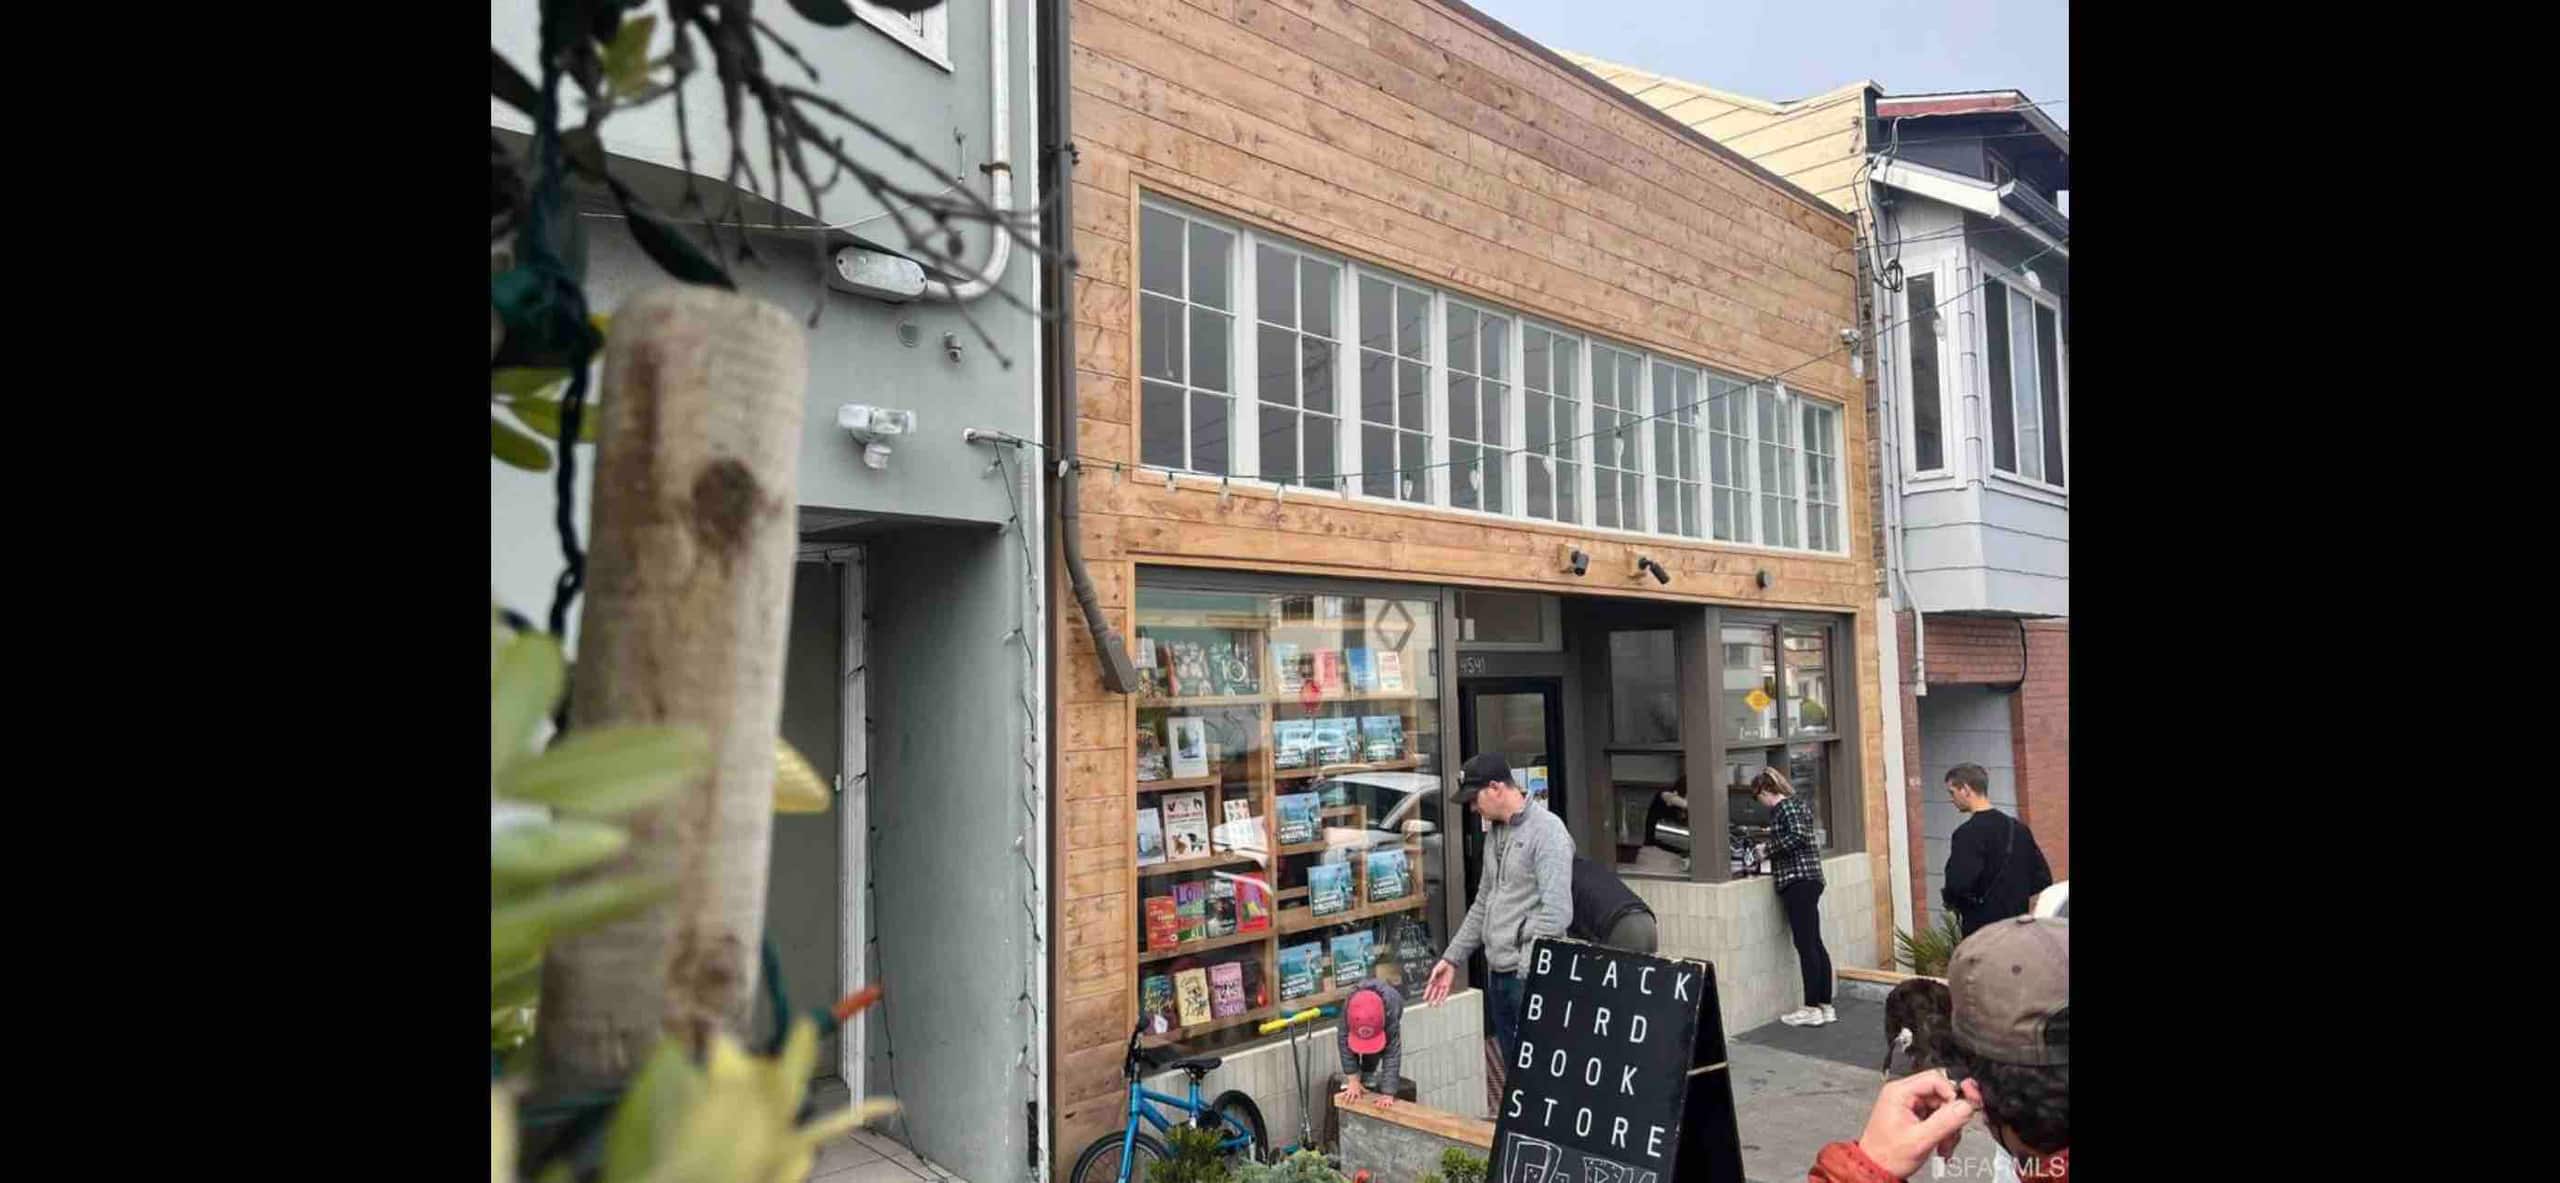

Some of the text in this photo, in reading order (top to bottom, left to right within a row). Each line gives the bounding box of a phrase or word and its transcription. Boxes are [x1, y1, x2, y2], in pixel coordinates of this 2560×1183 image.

[1536, 949, 1691, 1001] BLACK
[1527, 994, 1648, 1043] BIRD
[1518, 1041, 1638, 1096] BOOK
[1508, 1089, 1665, 1157] STORE
